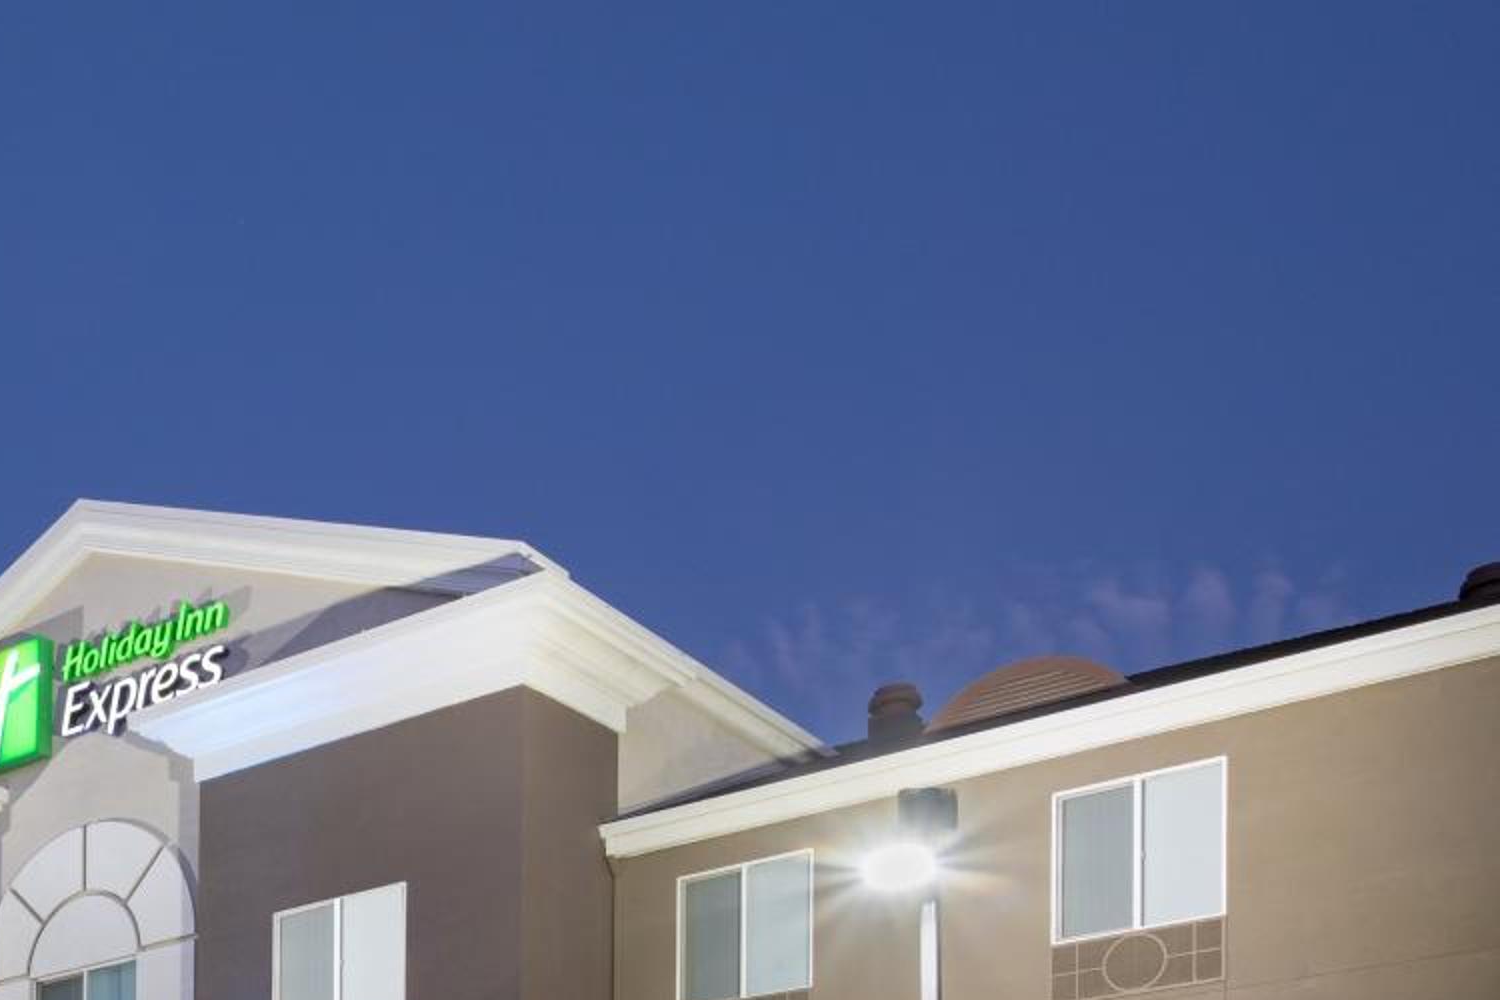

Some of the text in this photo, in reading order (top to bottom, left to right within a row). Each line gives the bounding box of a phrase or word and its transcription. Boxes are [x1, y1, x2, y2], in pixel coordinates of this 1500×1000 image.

[62, 600, 229, 682] Holiday Inn
[61, 644, 225, 737] Express
